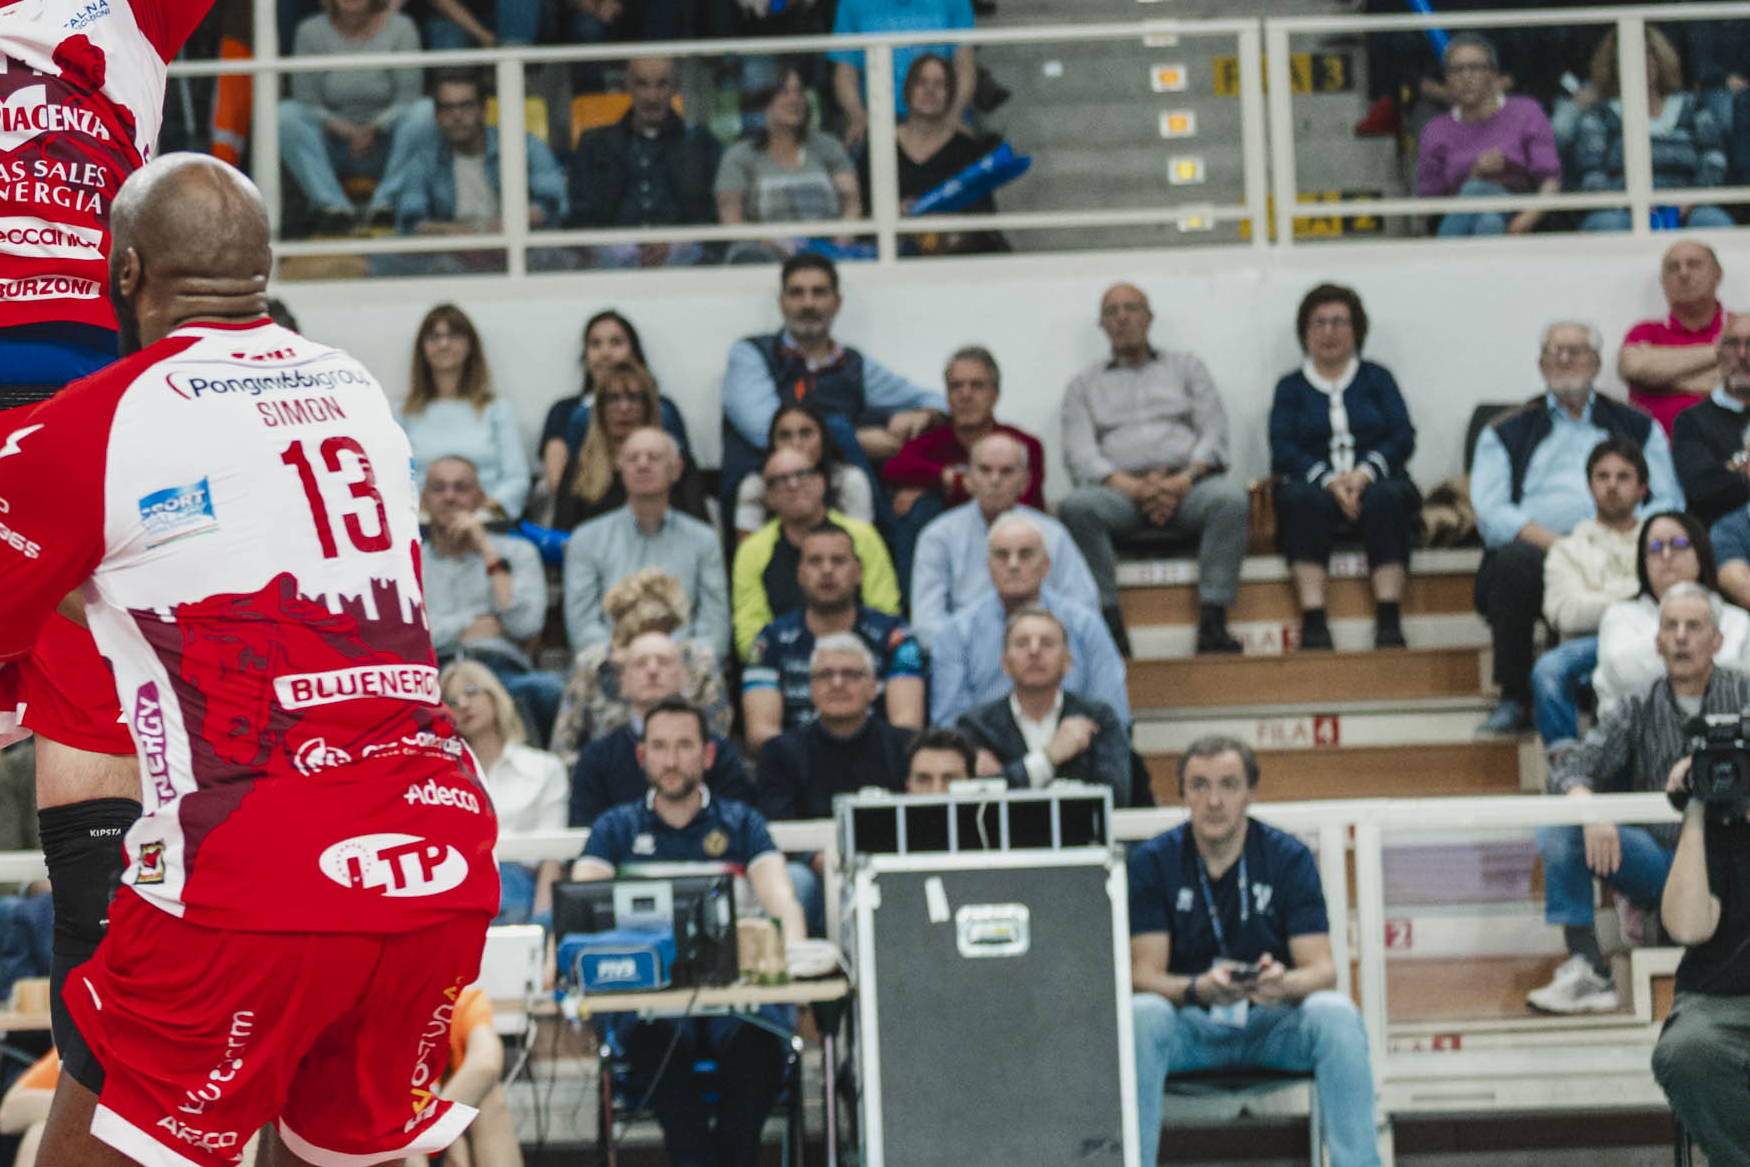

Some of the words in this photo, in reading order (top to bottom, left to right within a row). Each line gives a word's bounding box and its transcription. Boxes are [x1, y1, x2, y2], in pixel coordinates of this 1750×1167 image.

[33, 159, 108, 188] SALES
[255, 395, 347, 428] SIMON
[280, 435, 393, 560] 13
[404, 778, 481, 815] Adecco
[89, 828, 123, 838] KIPSTA
